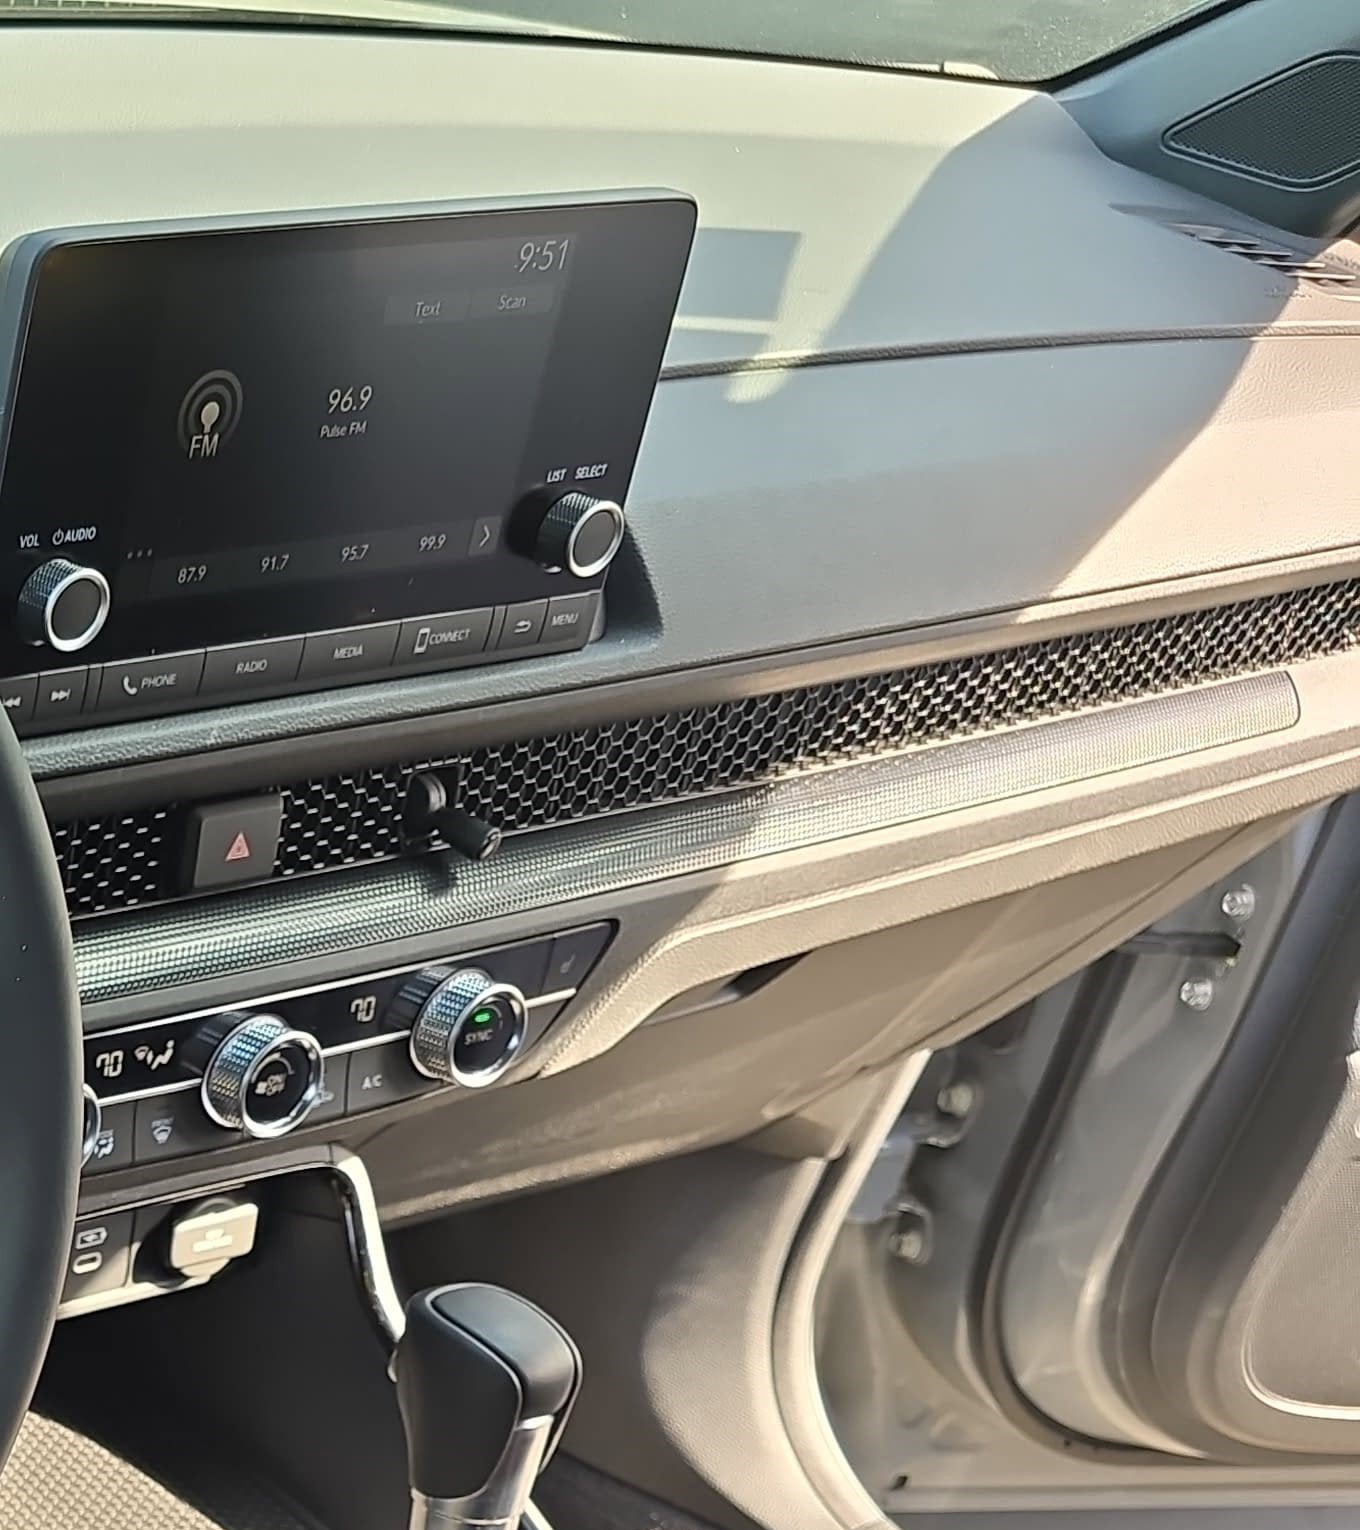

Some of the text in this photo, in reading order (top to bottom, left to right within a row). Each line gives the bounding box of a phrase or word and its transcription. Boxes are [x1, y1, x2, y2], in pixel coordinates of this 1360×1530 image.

[519, 239, 569, 273] 9:51
[415, 301, 441, 318] Text
[497, 293, 527, 311] Scan
[328, 385, 373, 414] 96.9
[320, 420, 367, 438] Pulse FM
[189, 433, 220, 459] FM
[547, 468, 567, 483] LIST
[575, 463, 608, 480] SELECT
[20, 533, 41, 549] VOL
[64, 526, 97, 543] AUDIO
[419, 534, 446, 551] 99.9
[341, 544, 369, 562] 95.7
[261, 554, 290, 572] 91.7
[177, 565, 207, 583] 87.9
[430, 627, 471, 645] CONNECT
[333, 643, 364, 659] MEDIA
[236, 658, 268, 675] RADIO
[141, 672, 177, 690] PHONE
[464, 1028, 494, 1046] SYNC
